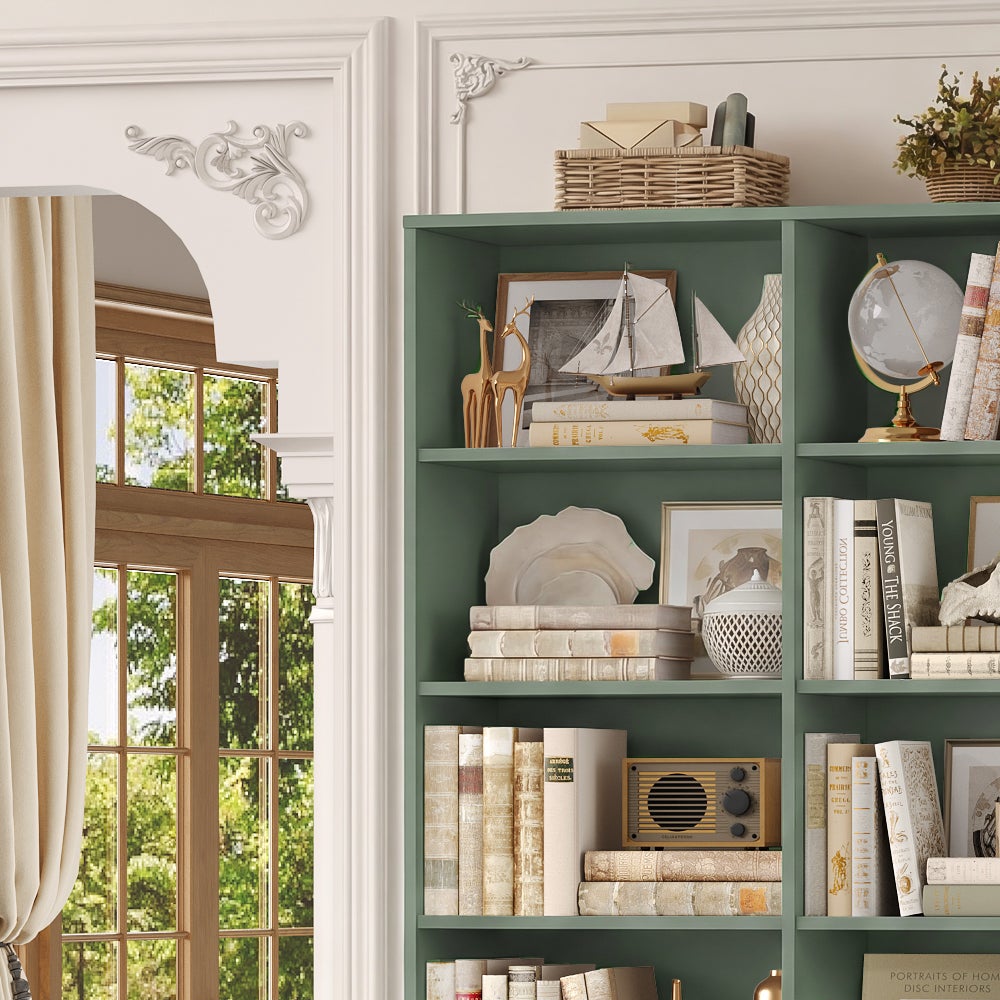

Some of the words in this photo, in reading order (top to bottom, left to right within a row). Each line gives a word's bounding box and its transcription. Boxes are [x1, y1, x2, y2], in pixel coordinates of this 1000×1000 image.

[882, 519, 896, 564] YOUNG
[885, 575, 900, 600] THE
[887, 603, 903, 644] SHACK
[890, 971, 948, 981] PORTRAITS
[952, 972, 968, 981] OF
[904, 984, 930, 993] DISC
[934, 984, 992, 993] INTERIORS
